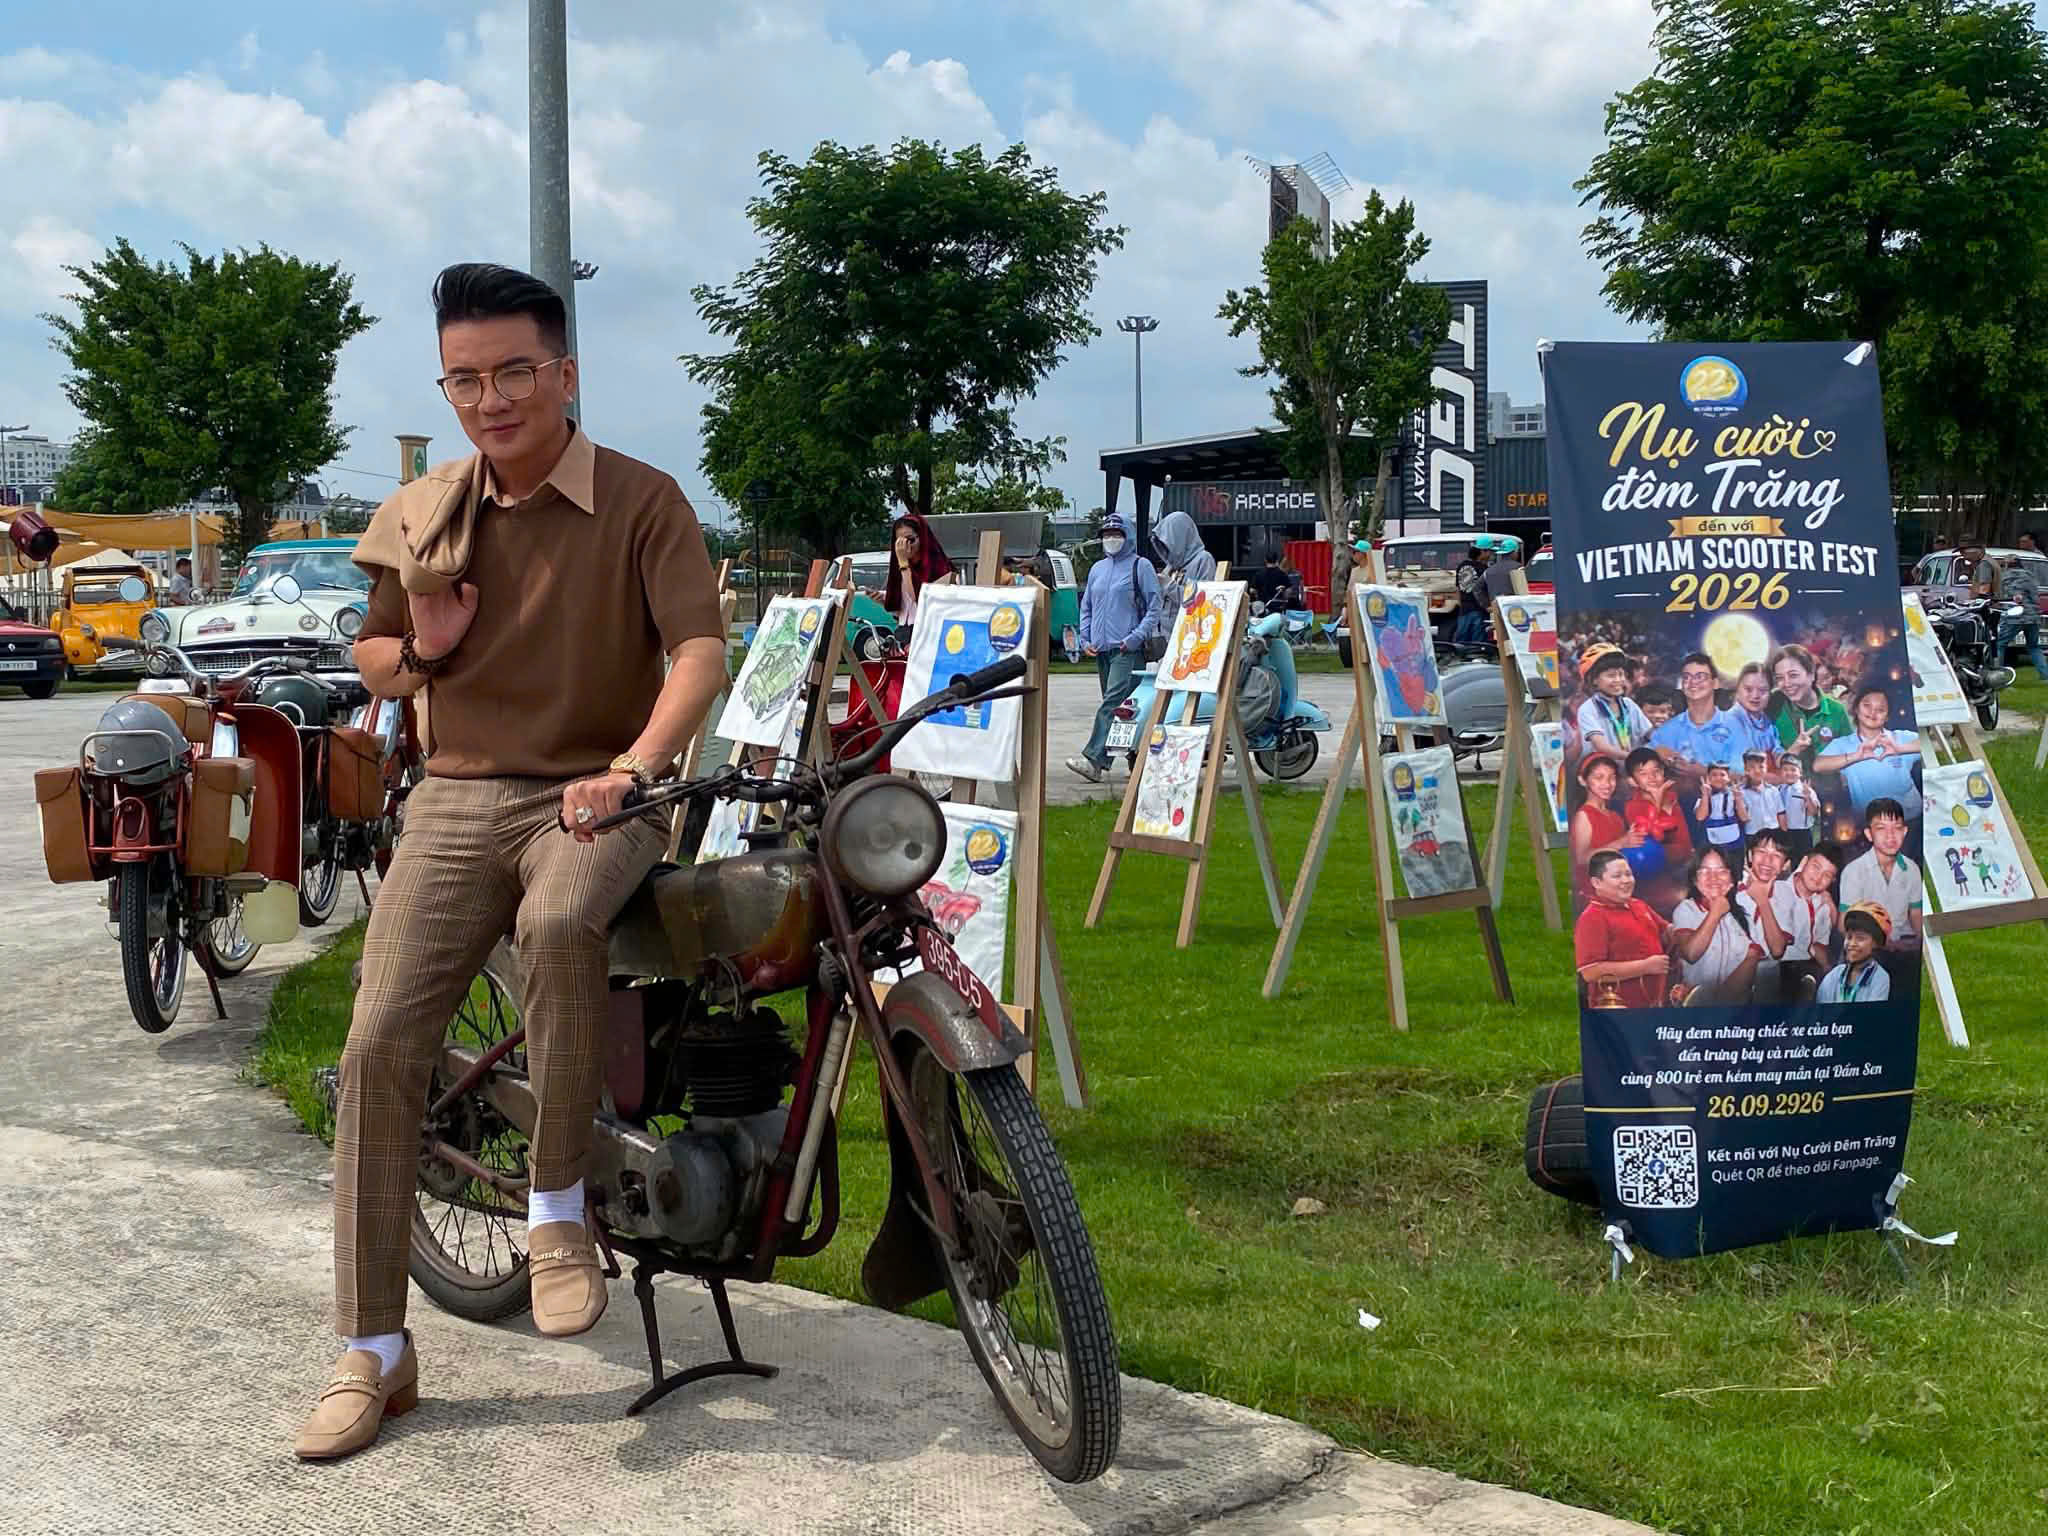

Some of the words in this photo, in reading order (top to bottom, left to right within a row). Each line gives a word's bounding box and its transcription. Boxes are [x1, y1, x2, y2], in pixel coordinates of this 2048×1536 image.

[1598, 402, 1700, 469] Nụ
[1713, 414, 1821, 459] cười
[1235, 492, 1316, 510] ARCADE
[1601, 466, 1699, 512] đêm
[1704, 458, 1845, 530] Trăng
[1698, 518, 1727, 531] đến
[1731, 519, 1754, 531] với
[1576, 539, 1695, 583] VIETNAM
[1702, 538, 1816, 573] SCOOTER
[1821, 542, 1878, 577] FEST
[1664, 572, 1791, 613] 2026
[1656, 1026, 1682, 1043] Hãy
[1715, 1026, 1755, 1041] những
[1758, 1022, 1788, 1038] chiếc
[1792, 1026, 1804, 1036] xe
[1807, 1022, 1828, 1036] của
[1831, 1022, 1853, 1038] bạn
[1678, 1046, 1700, 1061] đến
[1704, 1048, 1737, 1064] trưng
[1741, 1046, 1764, 1063] bày
[1767, 1046, 1782, 1060] và
[1784, 1045, 1810, 1059] rước
[1621, 1071, 1652, 1088] cùng
[1656, 1070, 1682, 1084] 800
[1684, 1070, 1702, 1083] trẻ
[1704, 1072, 1722, 1083] em
[1726, 1070, 1752, 1083] kém
[1755, 1071, 1782, 1085] may
[1814, 1066, 1830, 1083] tại
[1862, 1061, 1883, 1076] Sen
[1707, 1149, 1731, 1162] Kết
[1734, 1147, 1755, 1161] nối
[1758, 1146, 1778, 1160] với
[1782, 1145, 1800, 1159] Nụ
[1803, 1141, 1831, 1156] Cười
[1834, 1140, 1861, 1152] Đêm
[1863, 1135, 1897, 1149] Trăng
[1711, 1168, 1744, 1184] Quét
[1746, 1167, 1764, 1182] QR
[1767, 1164, 1782, 1178] để
[1784, 1162, 1809, 1176] theo
[1812, 1160, 1831, 1173] dõi
[1833, 1155, 1882, 1171] Fanpage.
